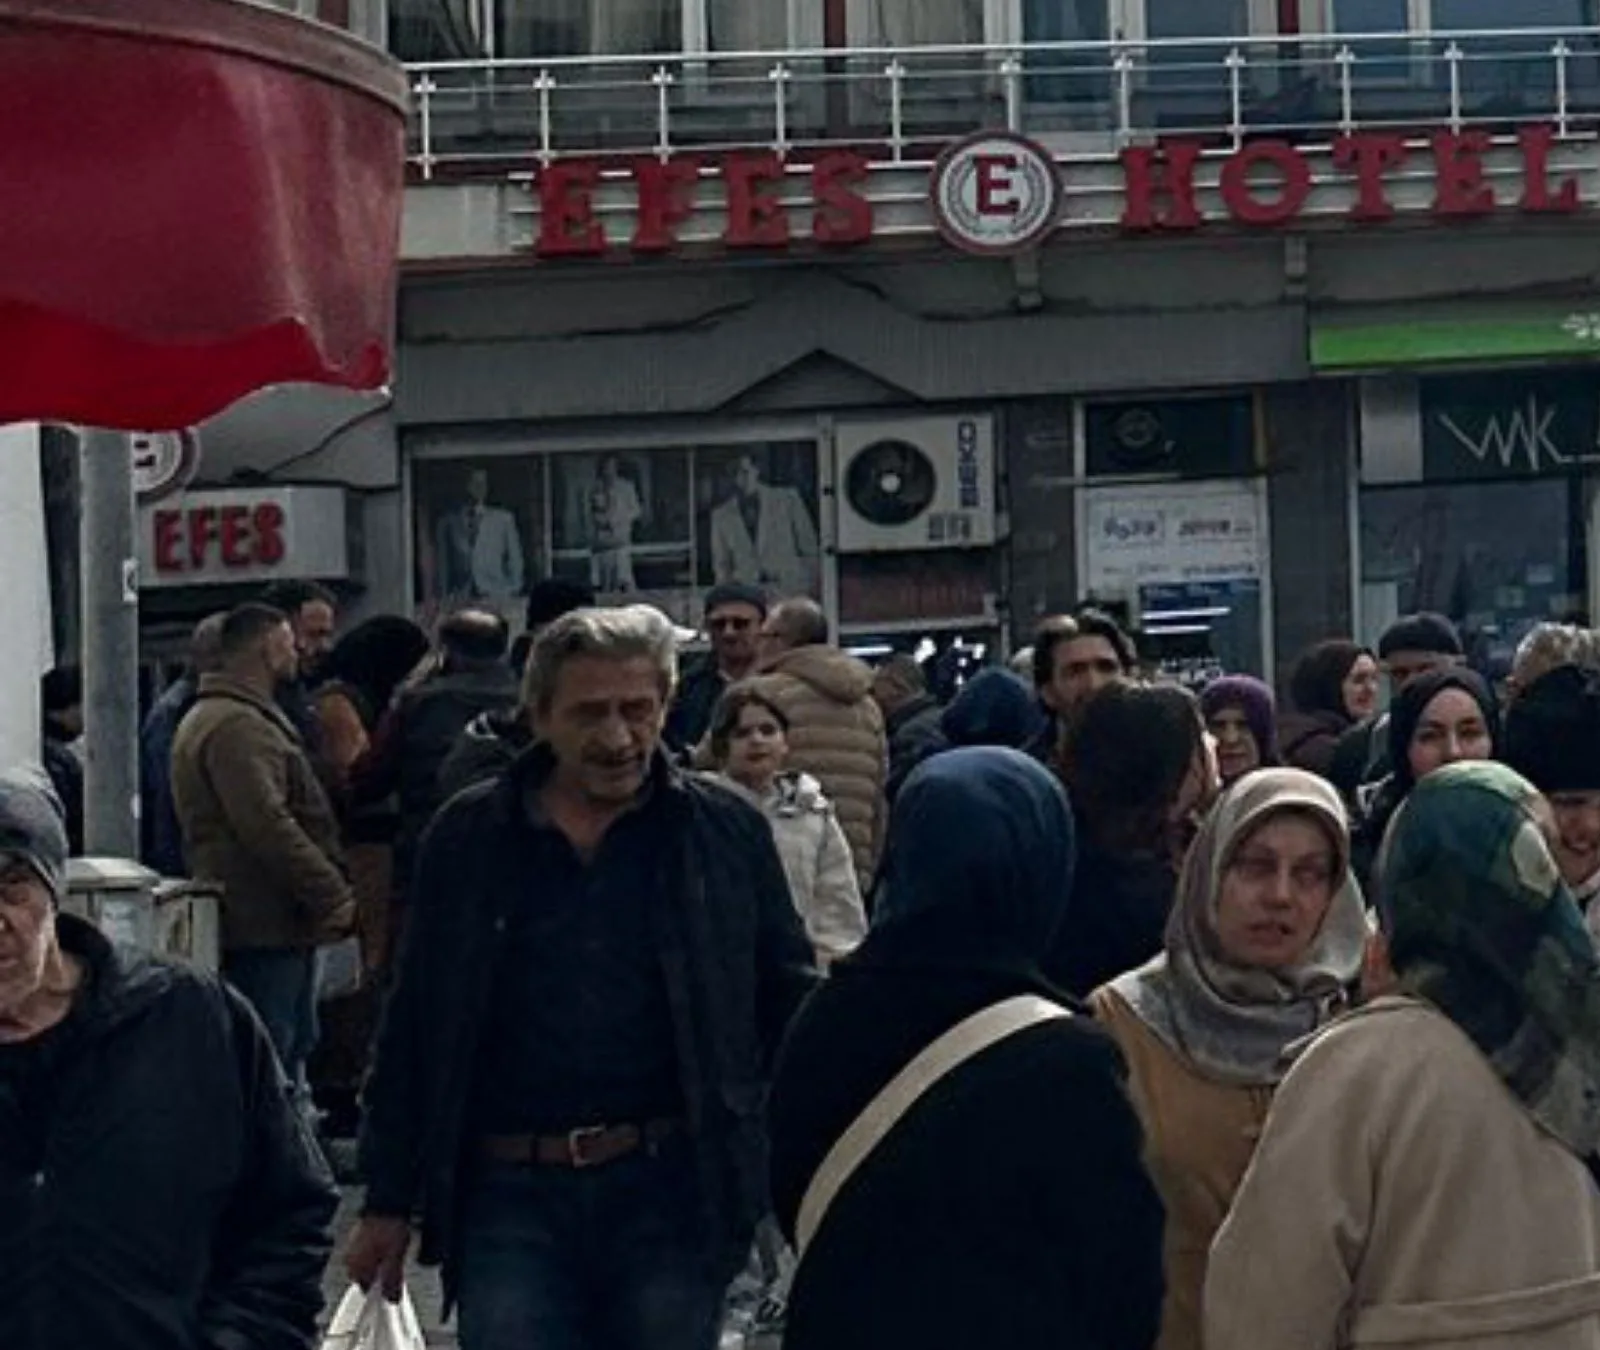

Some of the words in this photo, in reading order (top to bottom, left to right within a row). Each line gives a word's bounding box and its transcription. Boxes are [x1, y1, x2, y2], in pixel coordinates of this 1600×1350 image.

[536, 150, 873, 257] EFES
[973, 155, 1020, 216] E
[1118, 123, 1580, 230] HOTEL
[154, 502, 287, 573] EFES
